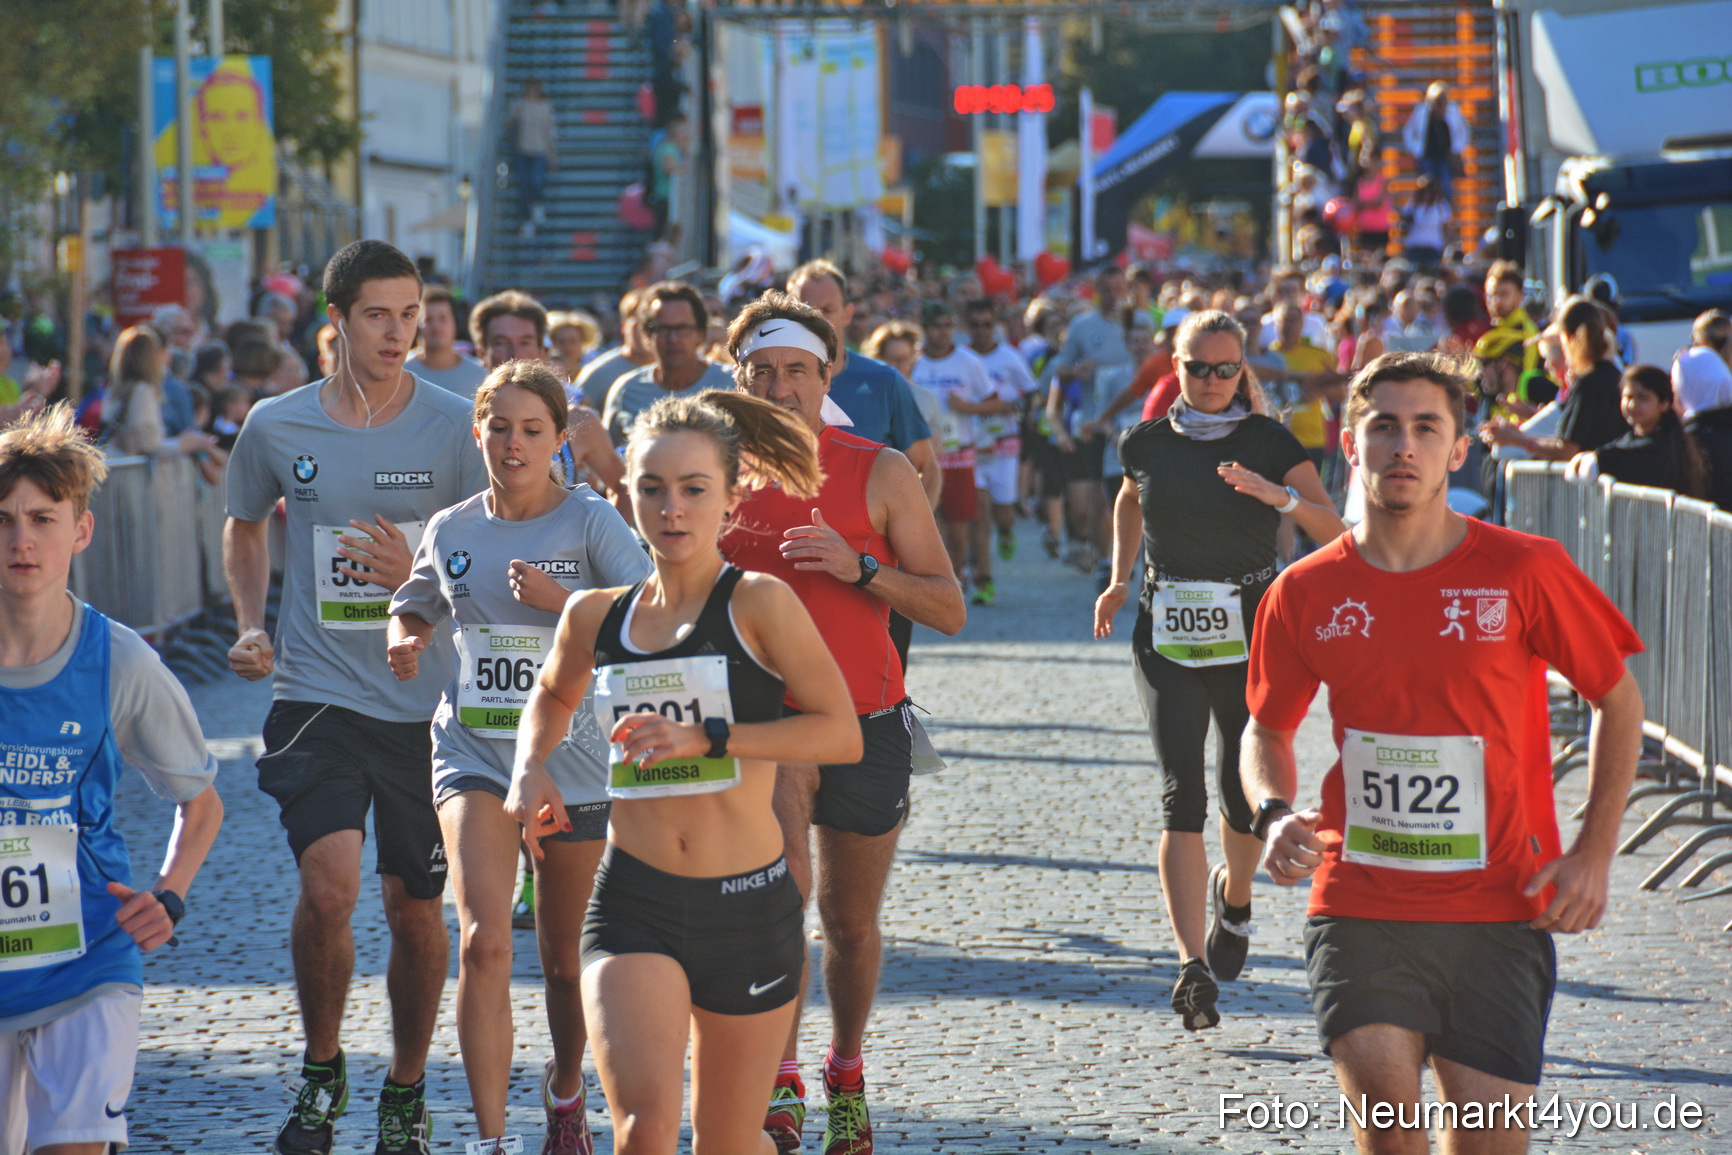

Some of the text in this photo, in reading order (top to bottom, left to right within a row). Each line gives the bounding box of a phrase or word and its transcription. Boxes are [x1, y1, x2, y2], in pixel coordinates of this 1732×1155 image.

[1635, 55, 1732, 93] BO
[375, 472, 433, 485] BOCK
[294, 488, 318, 497] PARTL
[1175, 590, 1213, 600] BOCK
[1440, 587, 1508, 597] TSV Wolfstein
[344, 604, 391, 619] Christi
[1165, 607, 1229, 632] 5059
[1315, 620, 1350, 642] Spitz
[490, 635, 541, 649] BOCK
[1187, 647, 1214, 658] Julia
[476, 657, 545, 692] 506
[626, 672, 684, 691] BOCK
[481, 696, 528, 705] PARTL Neuma
[0, 743, 83, 756] ersicherungsbüro
[1376, 747, 1438, 763] BOCK
[0, 751, 71, 770] EIDL &
[0, 767, 77, 785] NDERST
[633, 764, 700, 782] Vanessa
[1362, 769, 1460, 813] 5122
[592, 803, 601, 811] DO
[25, 810, 73, 826] Roth
[1371, 816, 1440, 830] PARTL Neumarkt
[0, 837, 31, 853] CK
[1371, 833, 1452, 856] Sebastian
[1, 863, 50, 909] 61
[721, 871, 767, 895] NIKE
[0, 936, 33, 954] lian
